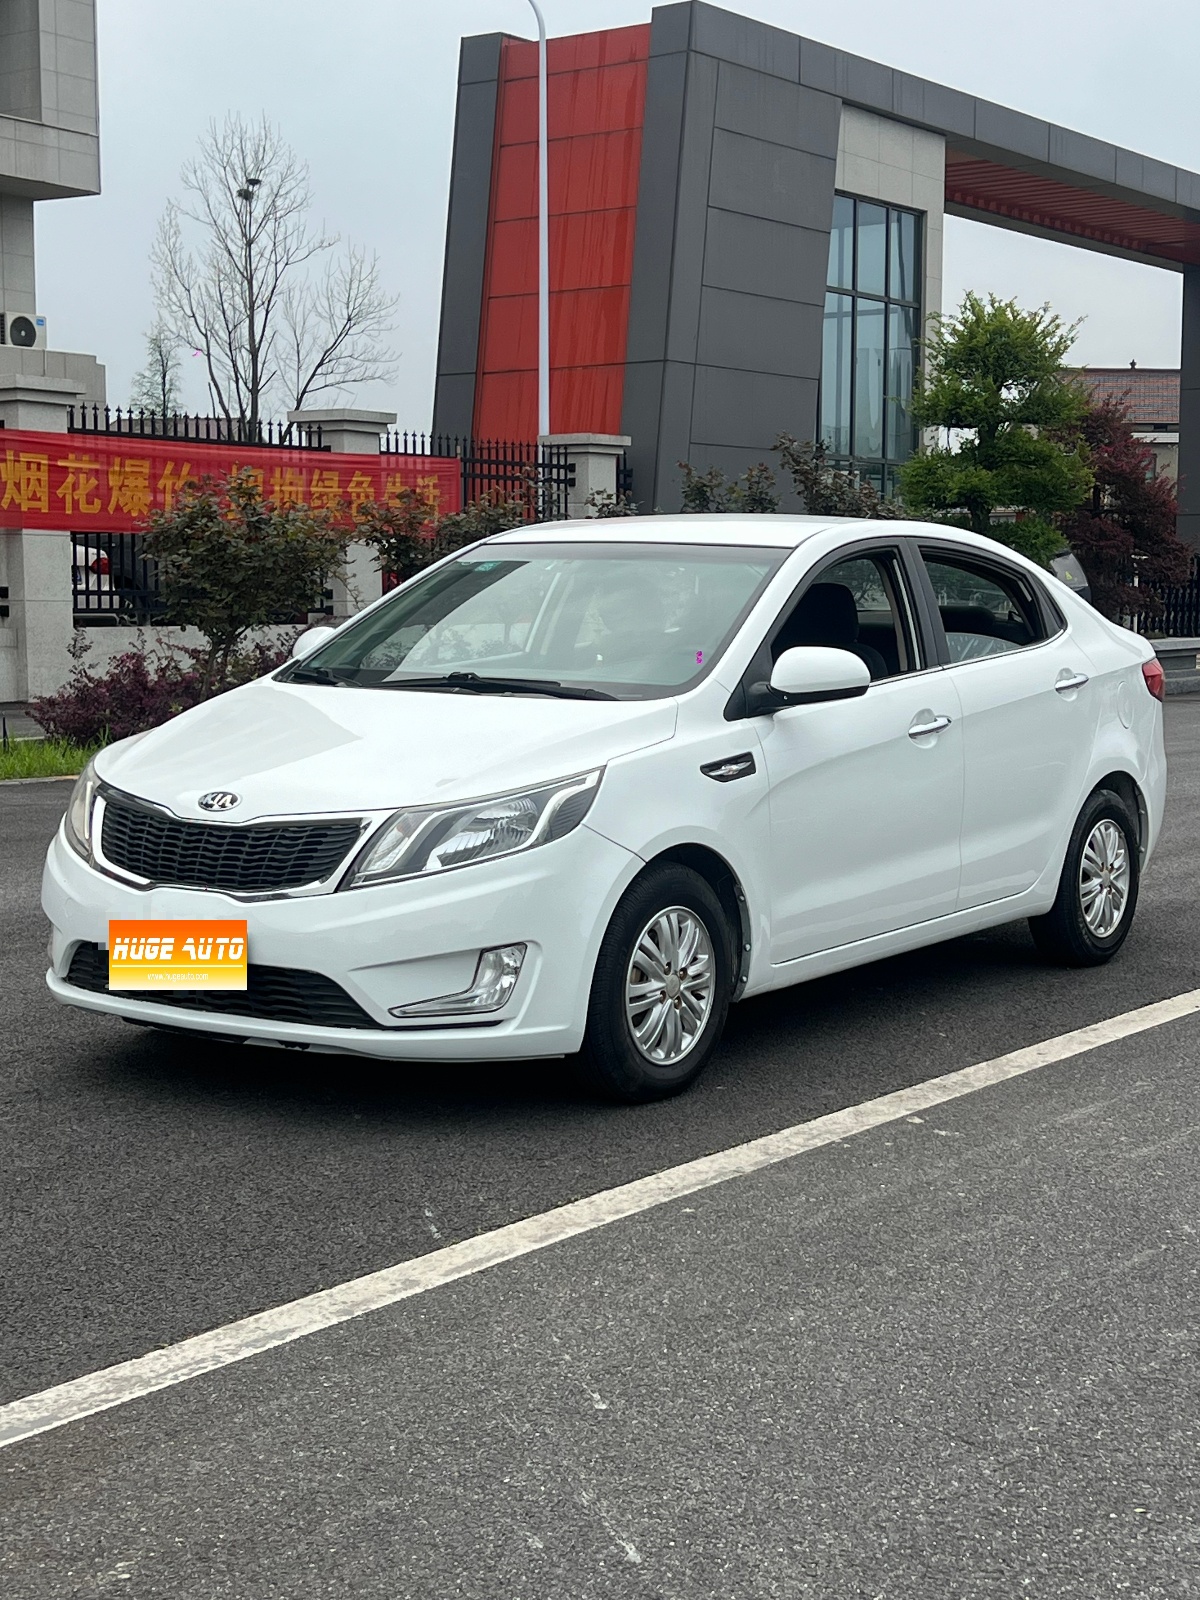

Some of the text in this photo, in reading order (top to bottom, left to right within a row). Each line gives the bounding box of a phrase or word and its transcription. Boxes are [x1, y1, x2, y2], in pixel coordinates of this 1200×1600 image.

[0, 450, 199, 516] 烟花爆竹
[201, 792, 235, 810] KIA
